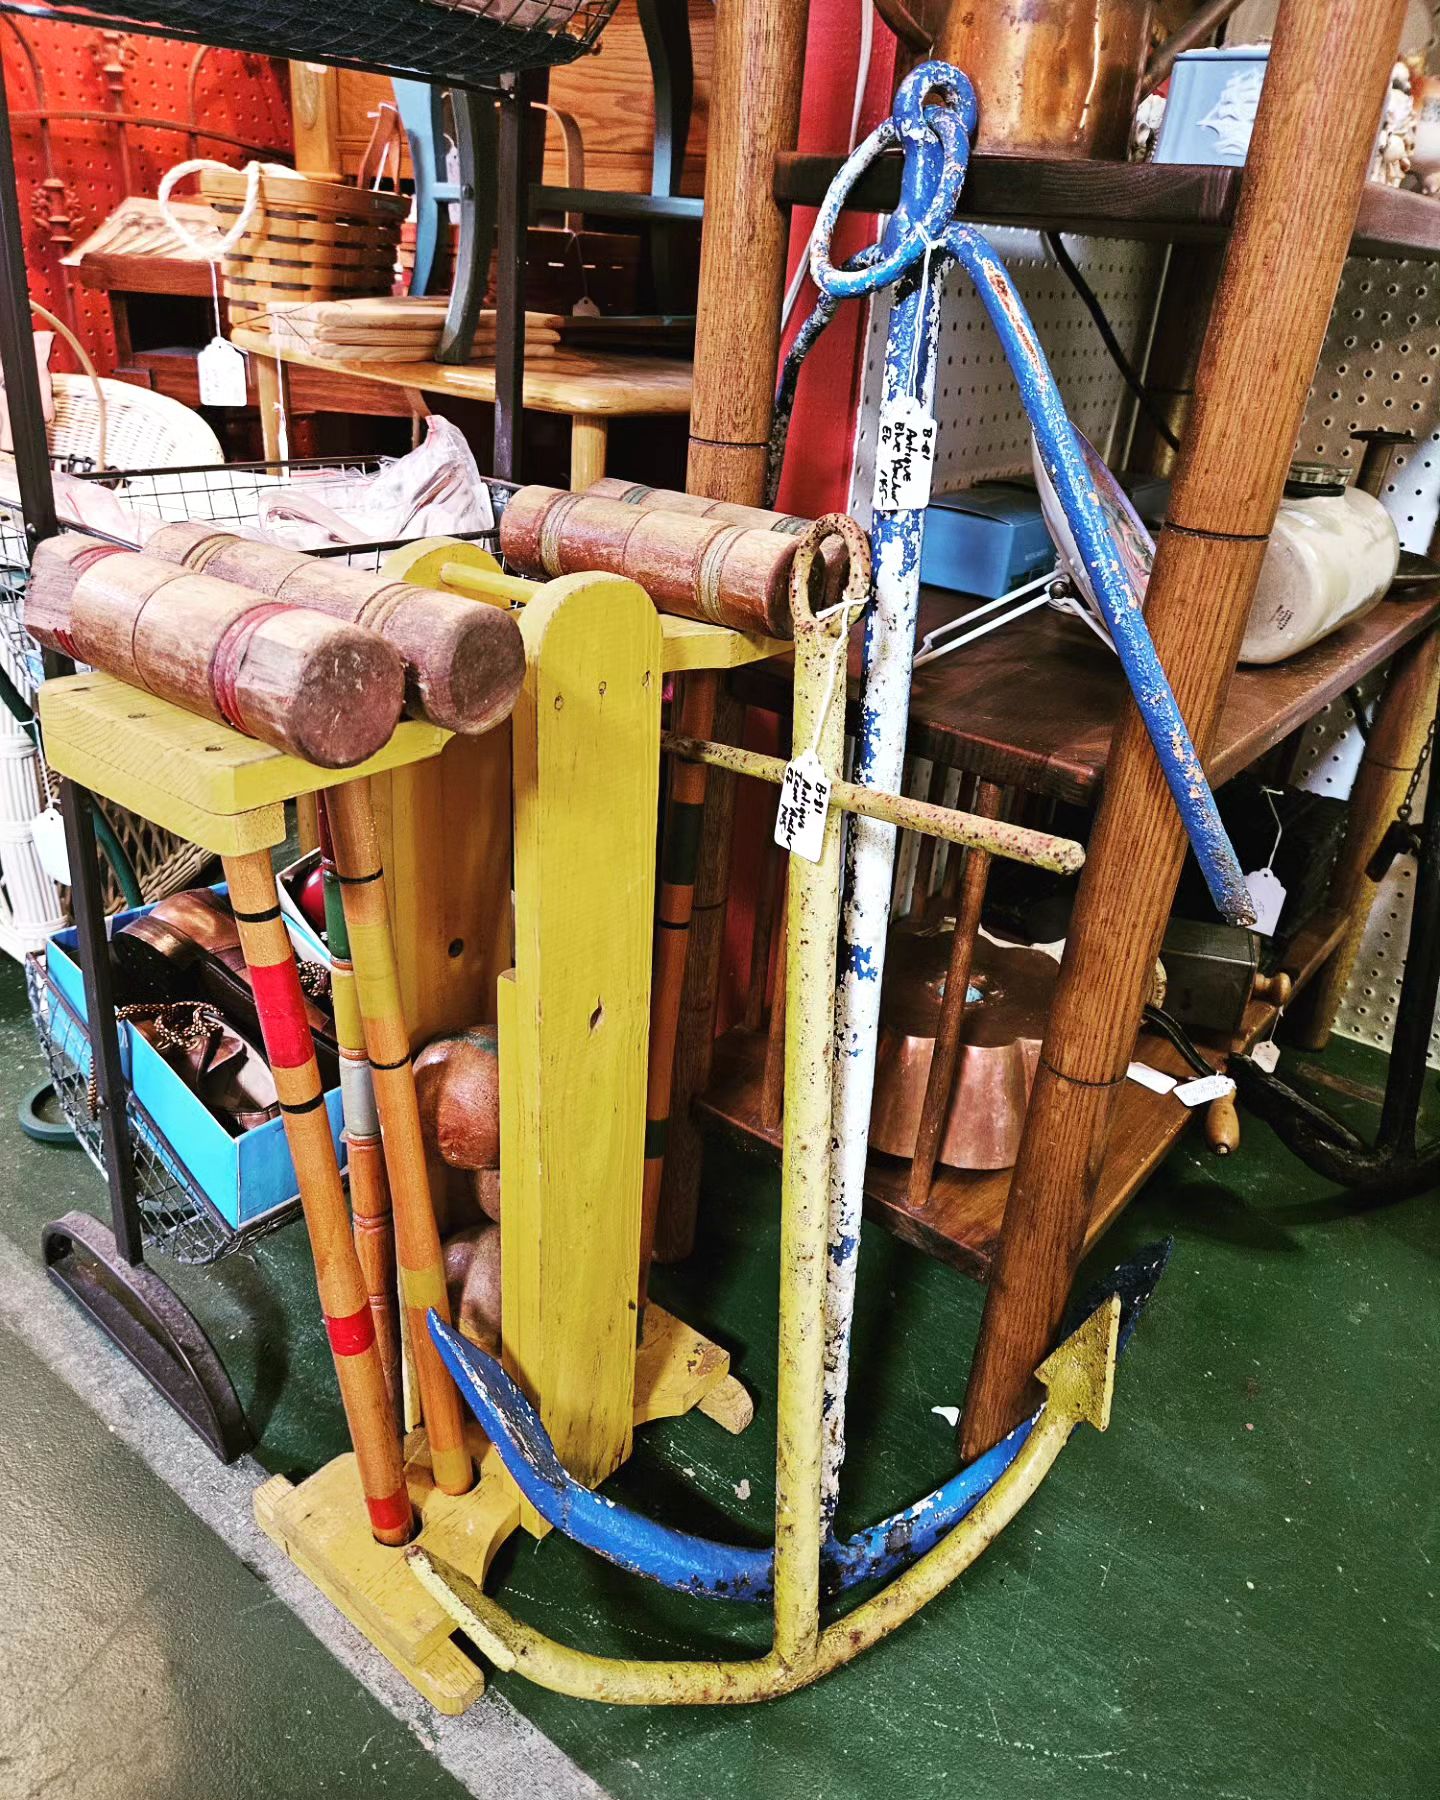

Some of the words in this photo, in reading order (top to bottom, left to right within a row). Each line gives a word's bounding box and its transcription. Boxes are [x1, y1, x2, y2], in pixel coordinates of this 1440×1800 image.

[893, 421, 905, 453] Blue
[891, 459, 903, 507] Anchor
[796, 778, 812, 830] Antique
[813, 781, 827, 815] B-81
